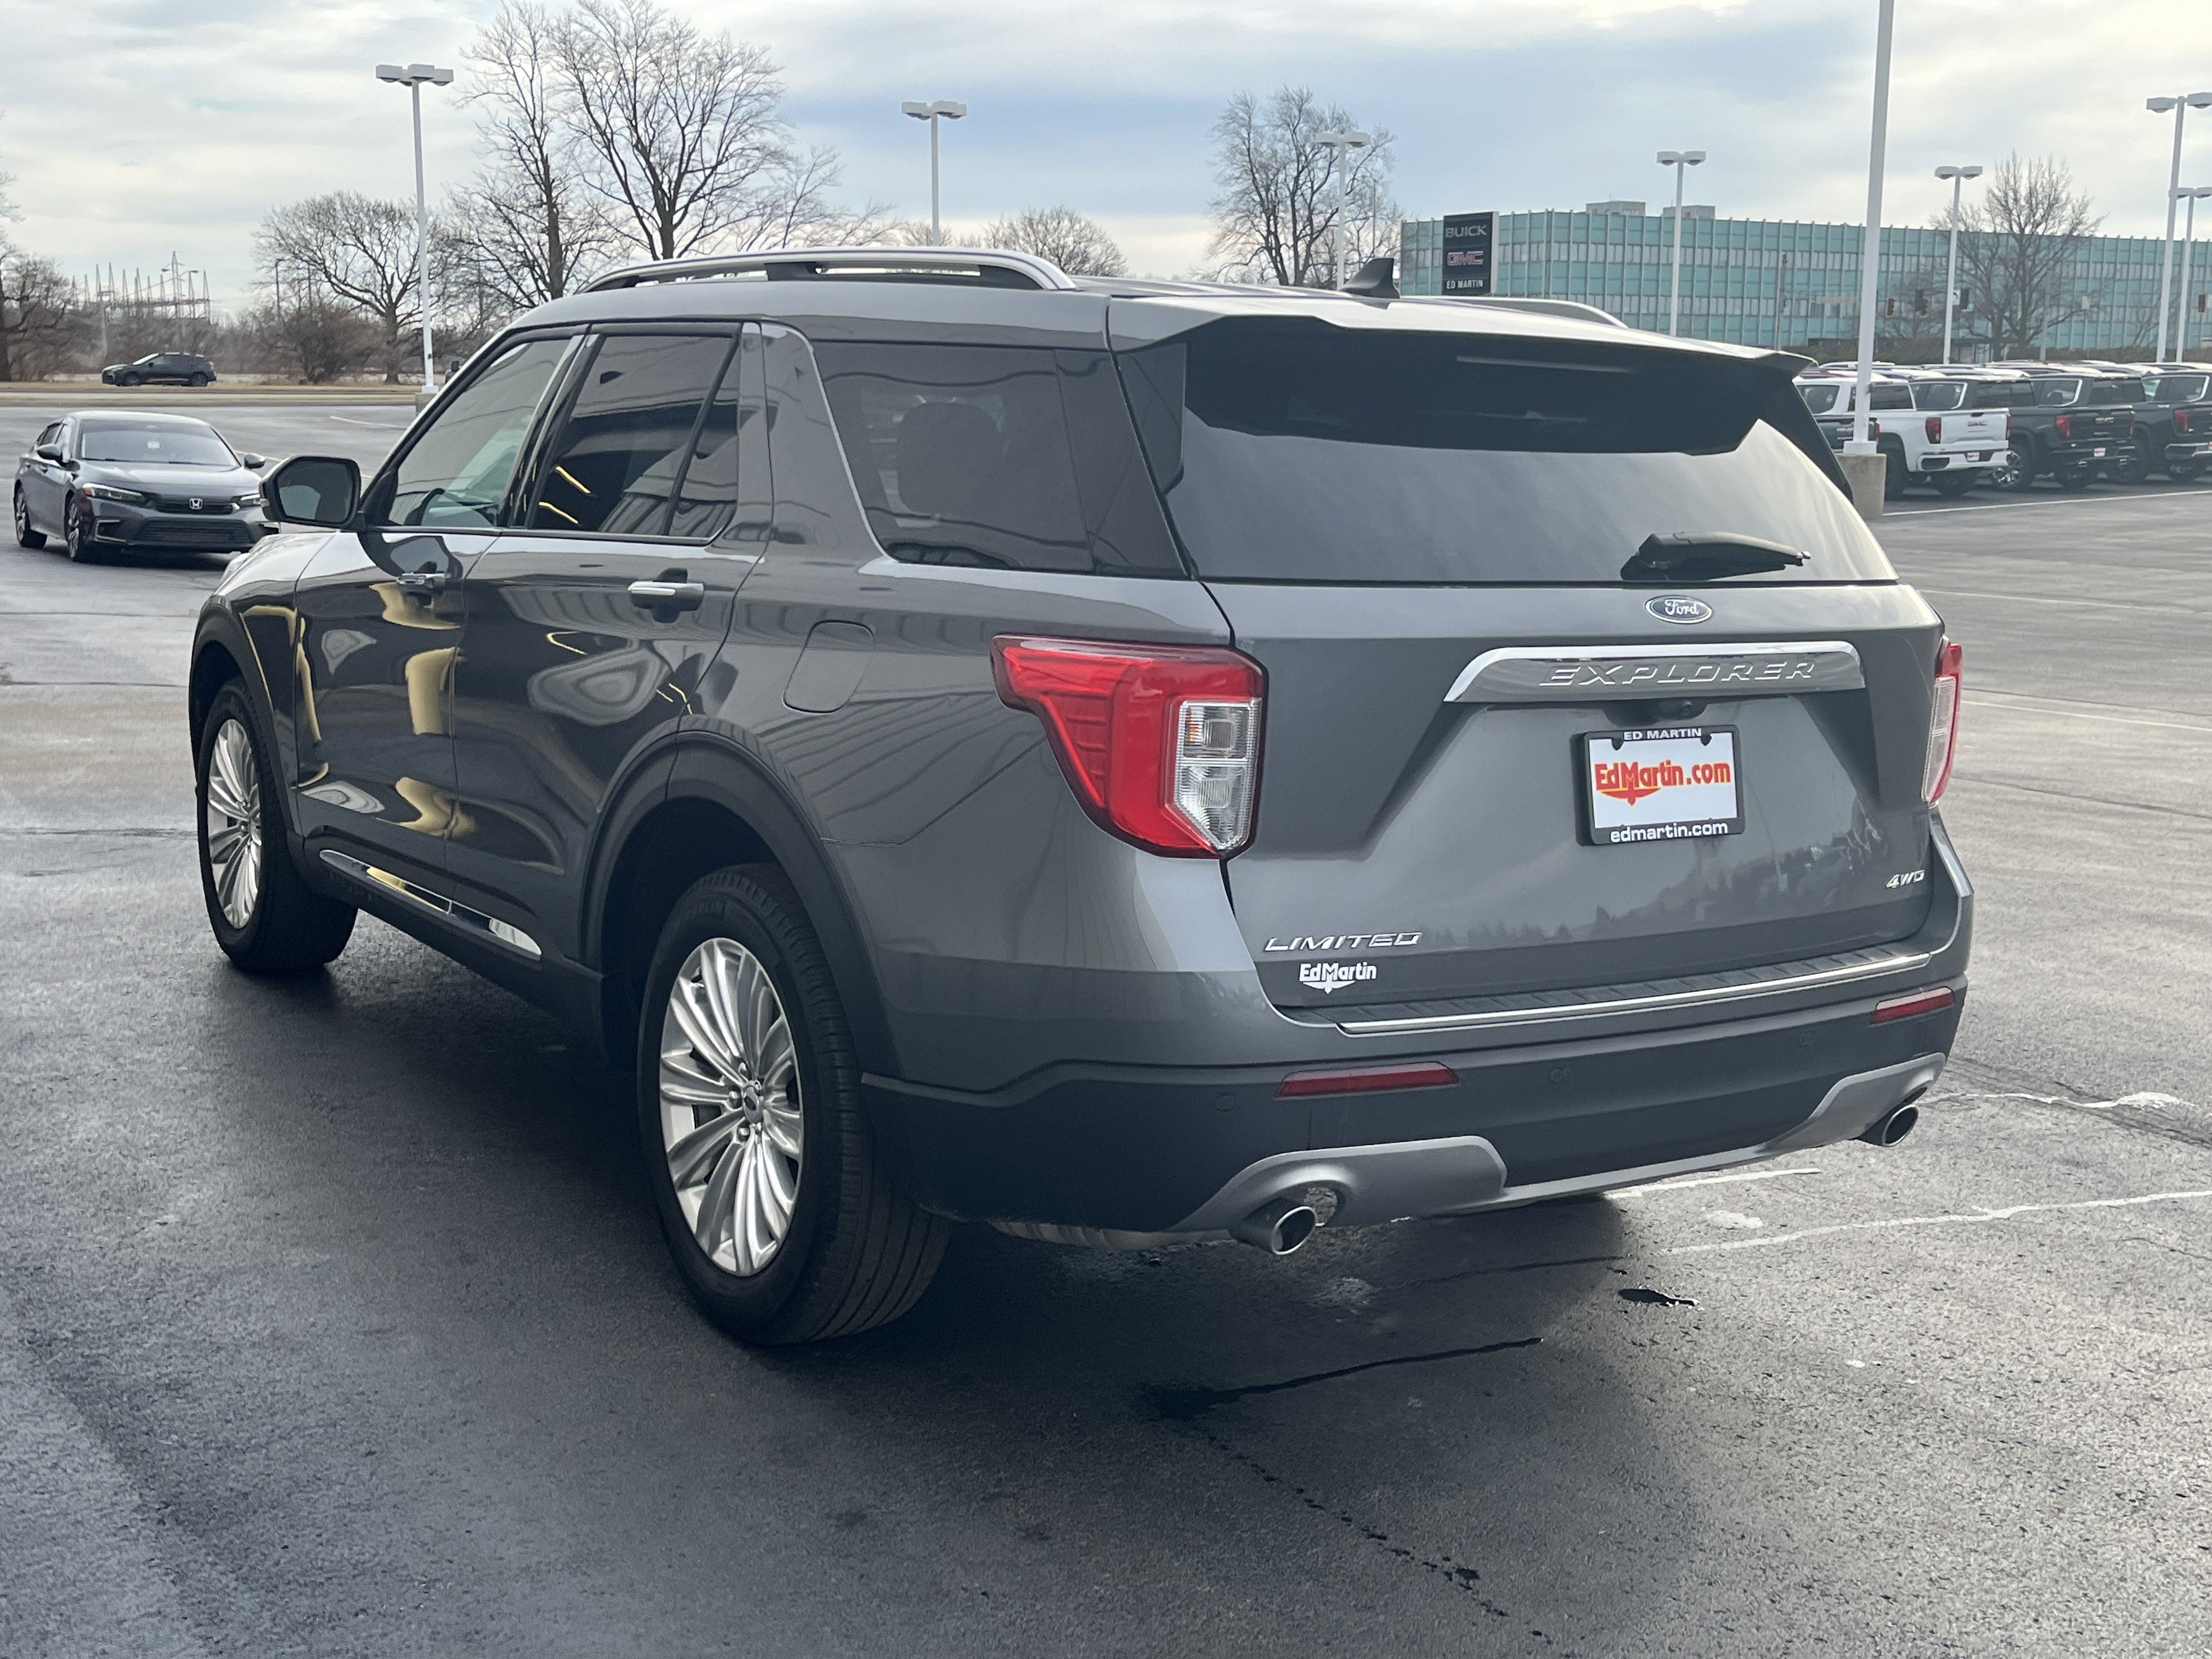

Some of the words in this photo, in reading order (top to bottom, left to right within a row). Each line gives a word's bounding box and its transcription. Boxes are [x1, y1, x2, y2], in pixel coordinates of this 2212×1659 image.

[1445, 225, 1487, 238] BUICK
[1447, 251, 1483, 266] GMC
[1446, 280, 1455, 289] ED
[1458, 280, 1483, 289] MARTIN
[1664, 599, 1700, 615] Ford
[1539, 662, 1815, 686] EXPLORER
[1623, 731, 1643, 741] ED
[1646, 728, 1702, 739] MARTIN
[1610, 822, 1728, 843] edmartin.com
[1886, 870, 1925, 888] 4WD
[1265, 933, 1422, 951] LIMITED
[1299, 962, 1376, 981] EdMartin
